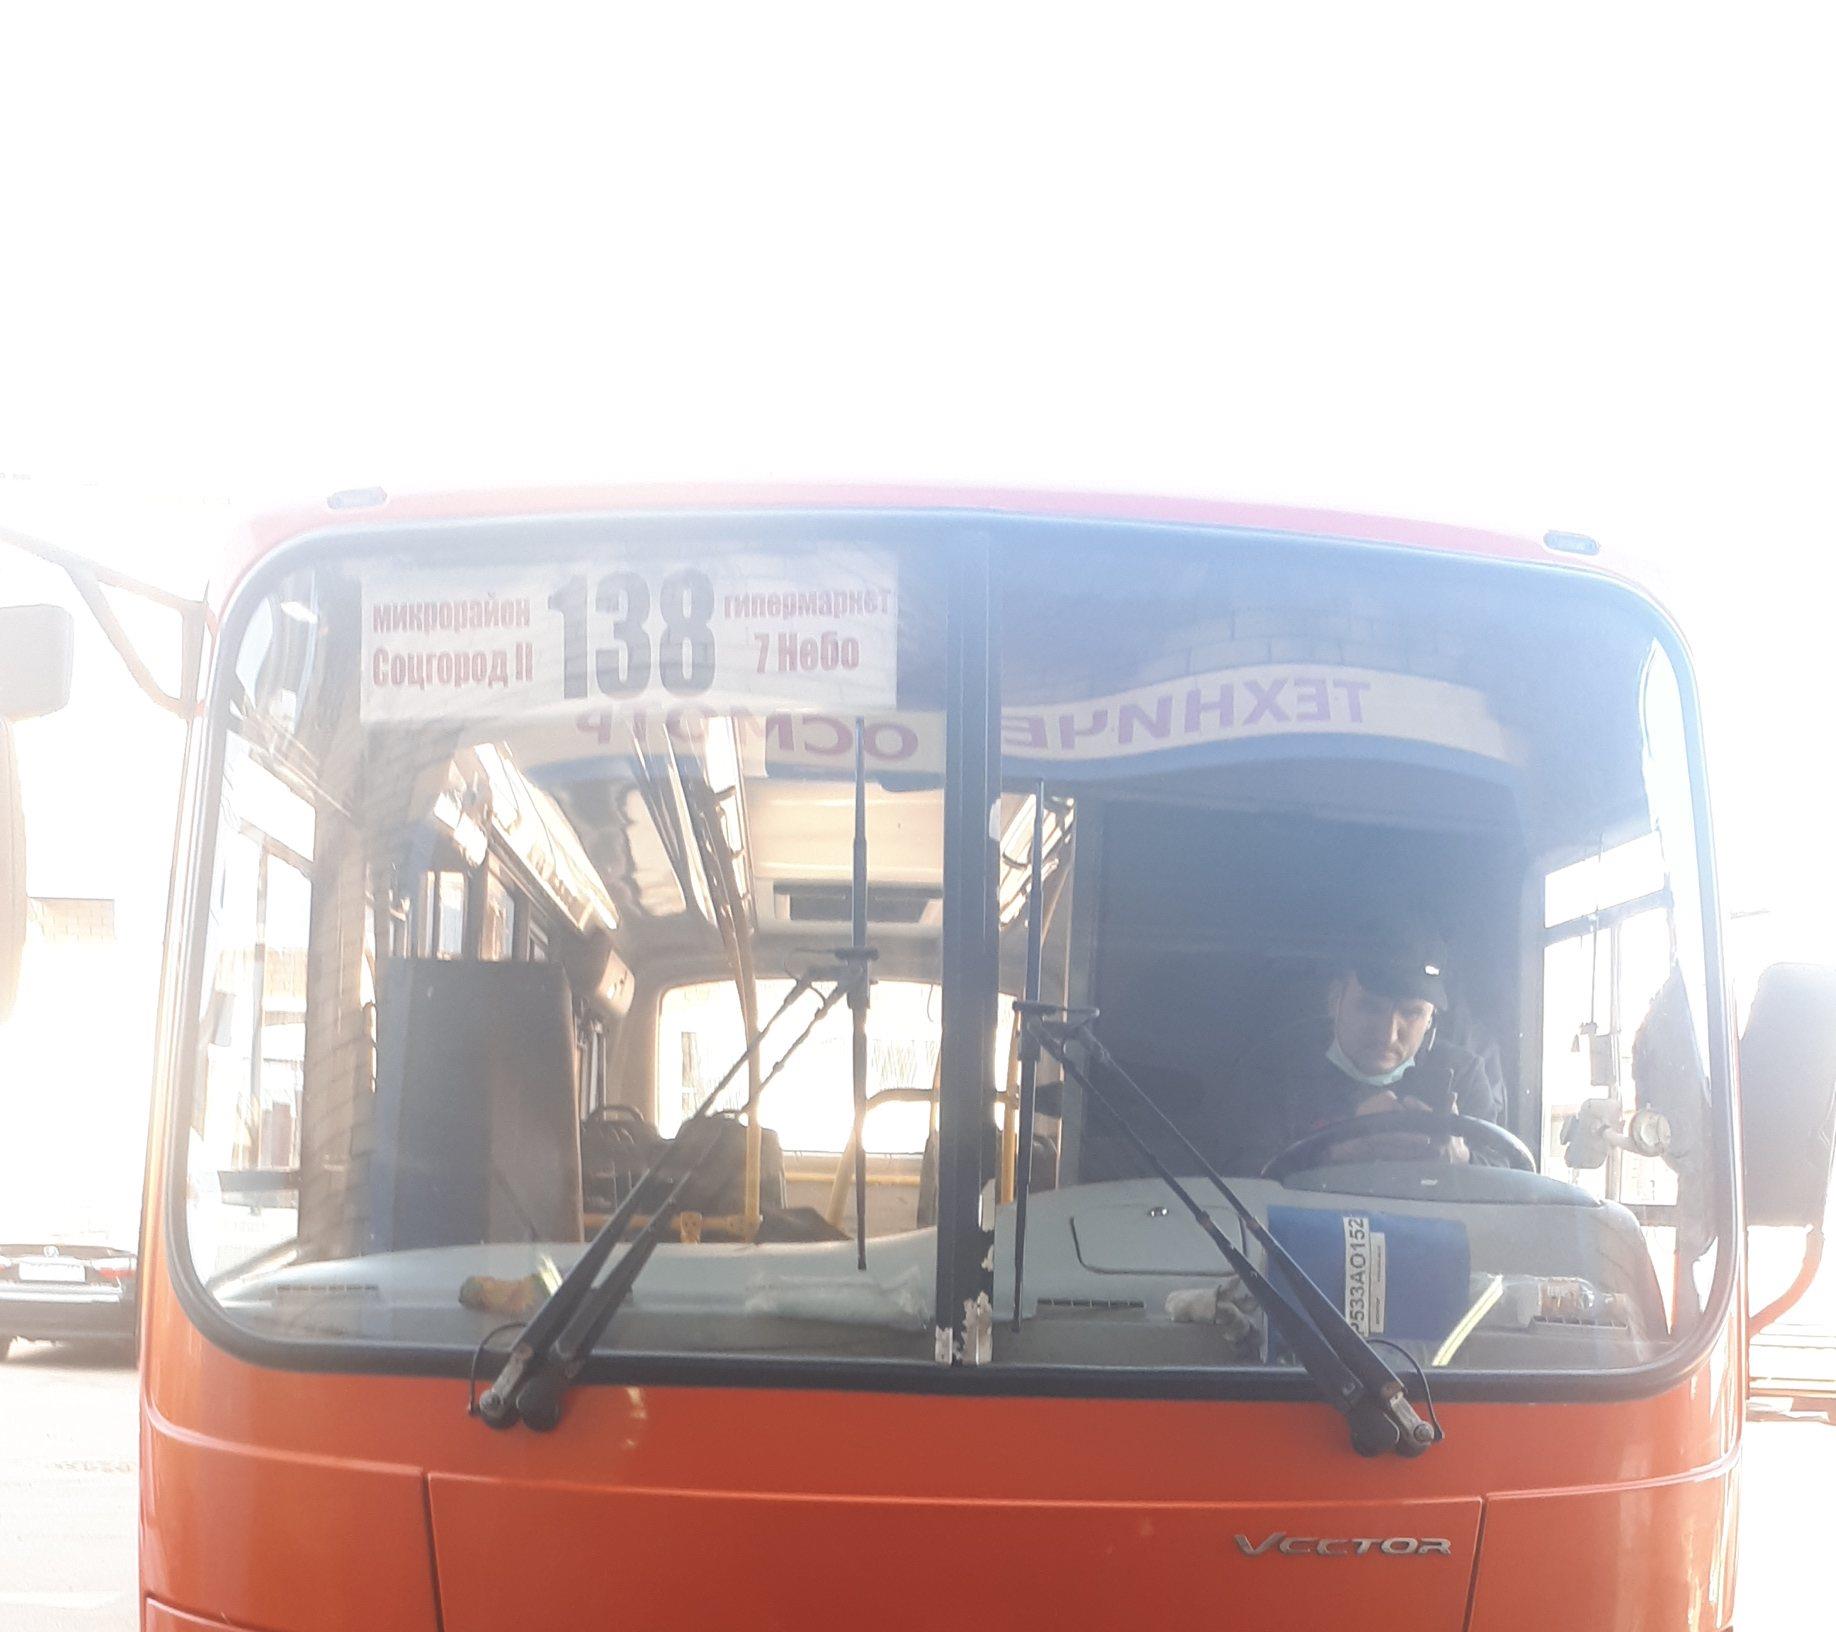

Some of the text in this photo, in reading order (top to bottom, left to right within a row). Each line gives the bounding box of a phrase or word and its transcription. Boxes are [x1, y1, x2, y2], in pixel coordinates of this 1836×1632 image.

[372, 592, 530, 634] микрорайон
[723, 586, 892, 620] гипермаркет
[547, 569, 716, 700] 138
[753, 630, 861, 674] 7 Небо
[372, 647, 509, 691] Соцгород
